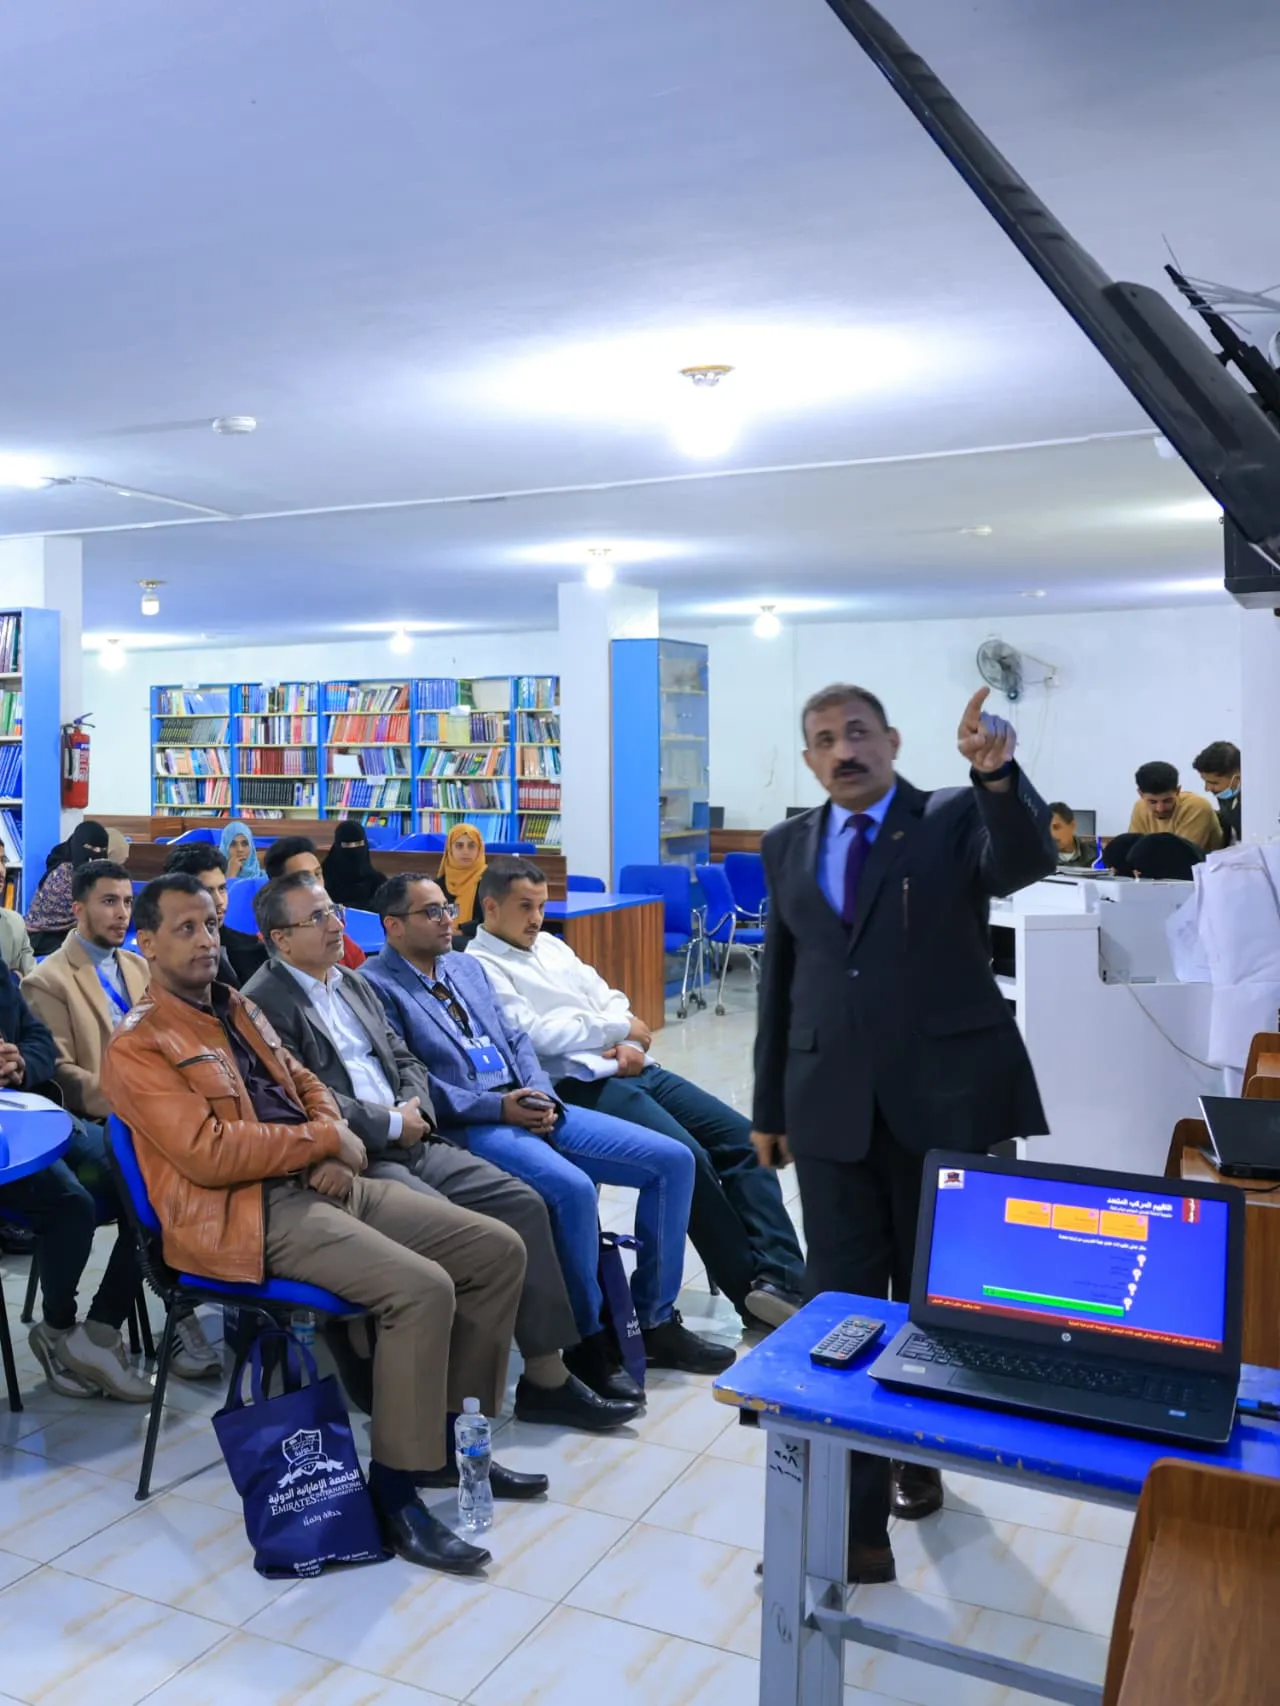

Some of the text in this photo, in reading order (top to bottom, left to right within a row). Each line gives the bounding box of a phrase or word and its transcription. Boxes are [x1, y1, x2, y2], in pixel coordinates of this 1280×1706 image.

[268, 1468, 360, 1505] الجامعة الإماراتية الدولية
[271, 1495, 317, 1516] EMIRATES
